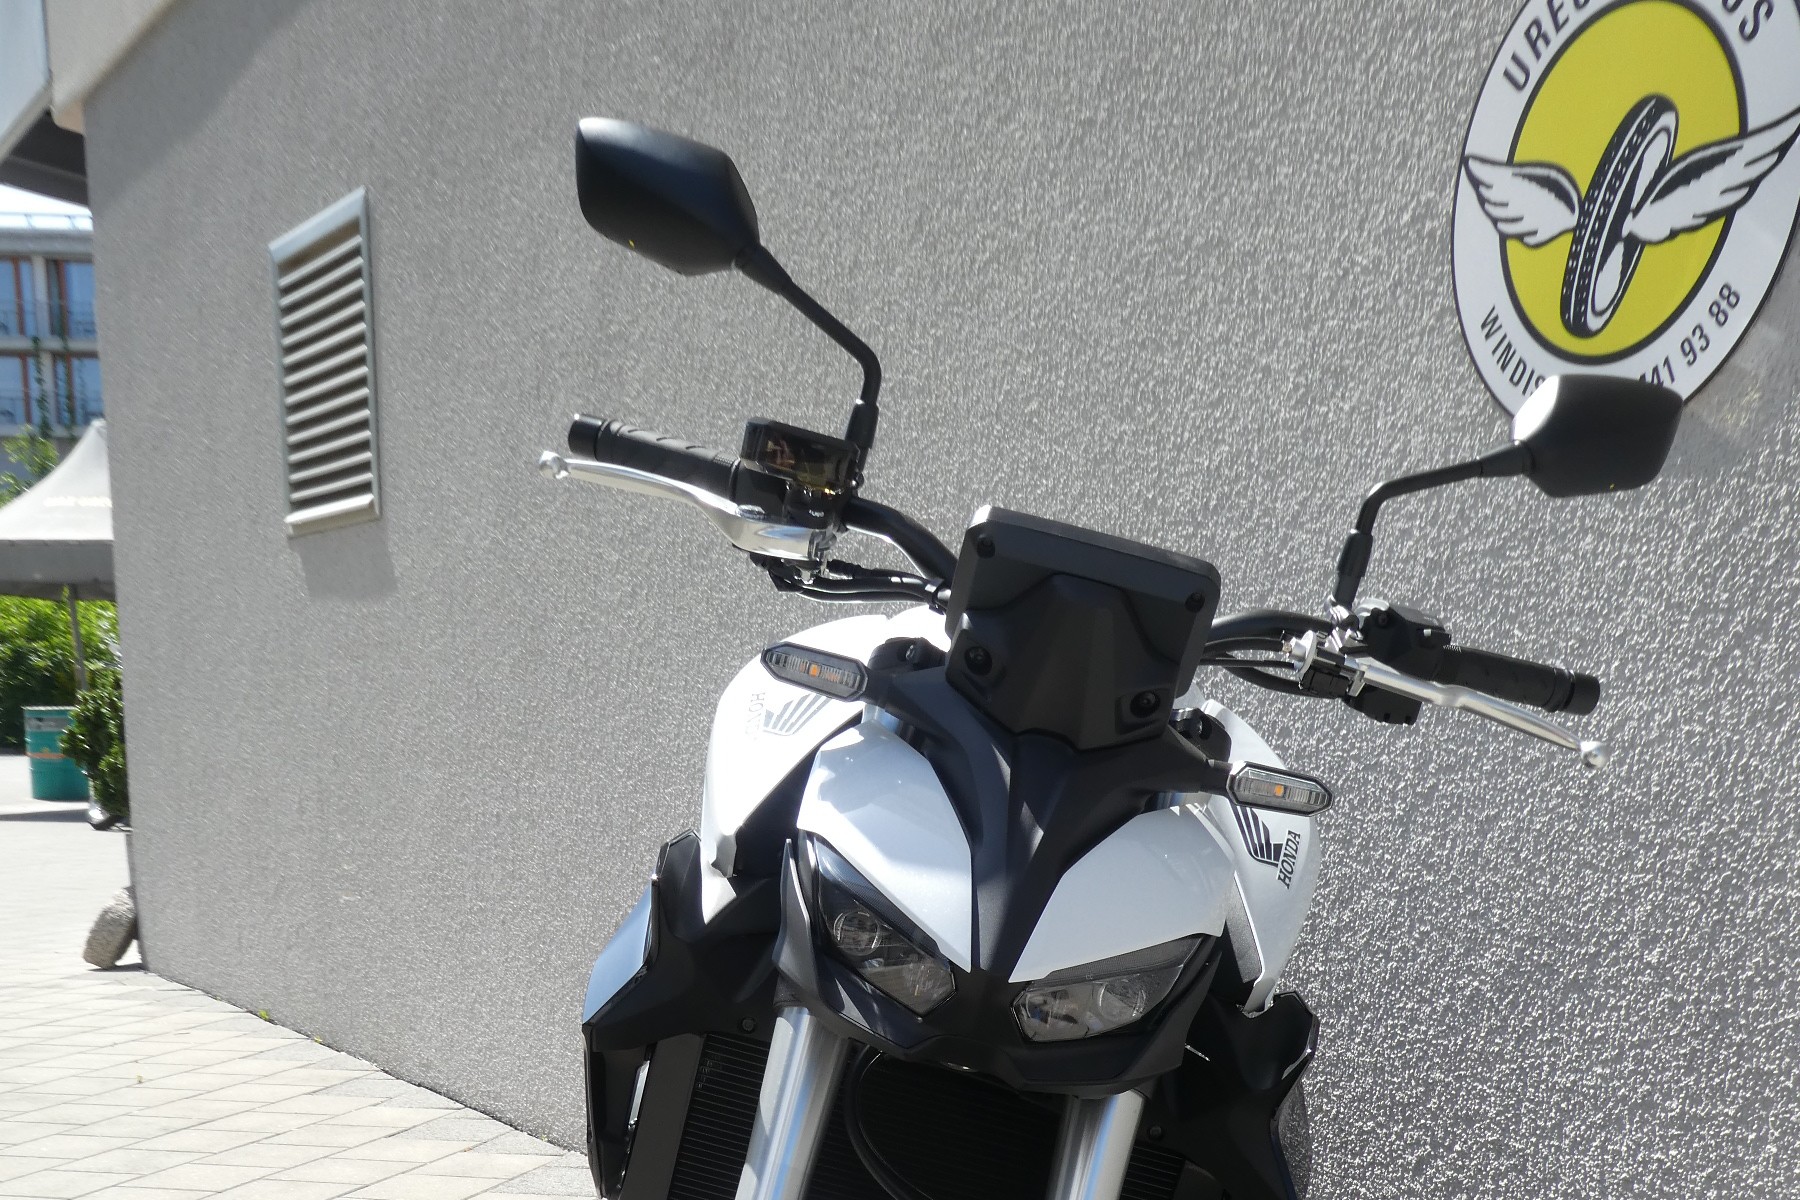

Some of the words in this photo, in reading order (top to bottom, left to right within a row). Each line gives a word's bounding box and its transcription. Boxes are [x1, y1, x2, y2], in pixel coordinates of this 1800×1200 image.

[1503, 0, 1590, 91] URE
[1680, 323, 1710, 367] 93
[1708, 282, 1740, 328] 88
[1277, 830, 1301, 890] HONDA
